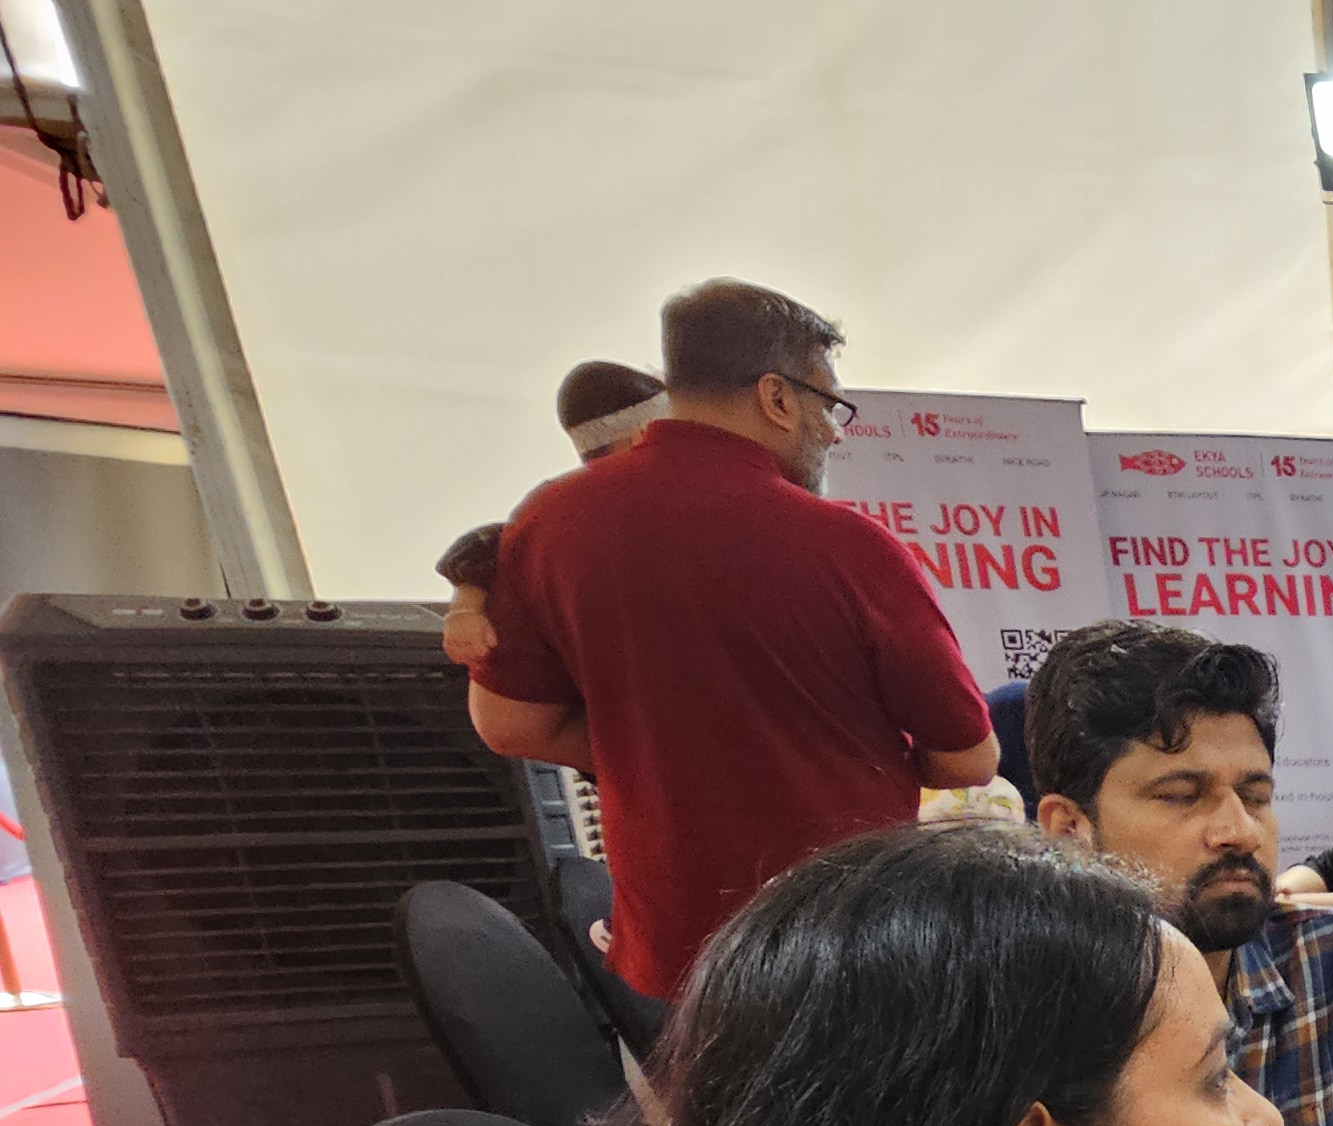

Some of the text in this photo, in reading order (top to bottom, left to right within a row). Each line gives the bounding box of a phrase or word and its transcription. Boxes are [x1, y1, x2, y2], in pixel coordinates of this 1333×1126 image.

[910, 412, 941, 437] 15
[1194, 450, 1226, 463] EKYA
[1271, 455, 1298, 478] 15
[1196, 466, 1254, 479] SCHOOLS
[930, 503, 1006, 538] JOY
[1019, 505, 1061, 539] IN
[1108, 537, 1191, 567] FIND
[1197, 537, 1273, 567] THE
